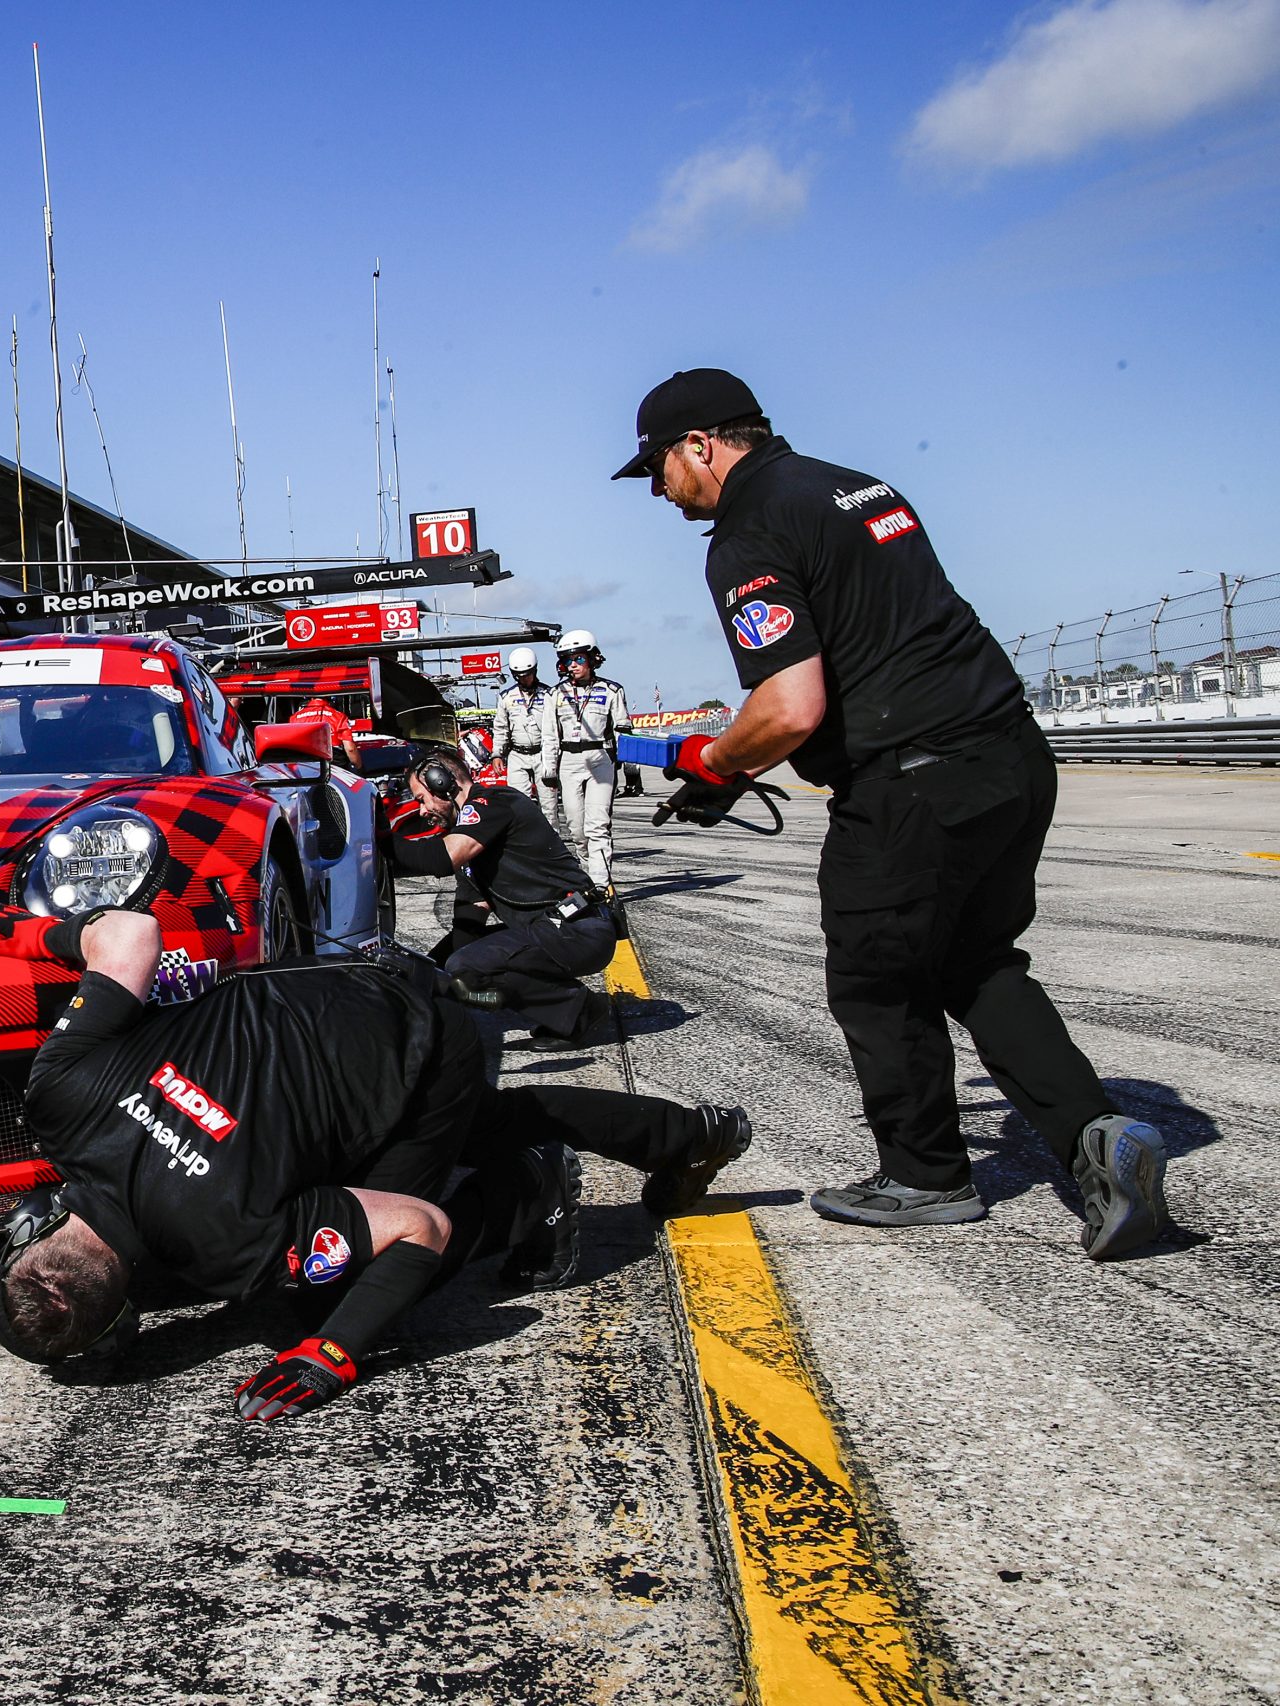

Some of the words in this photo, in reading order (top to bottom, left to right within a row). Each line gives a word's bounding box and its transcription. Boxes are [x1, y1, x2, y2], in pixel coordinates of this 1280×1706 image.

[832, 482, 895, 511] driveway
[422, 521, 465, 555] 10
[869, 510, 915, 541] MOTUL
[368, 567, 429, 583] ACURA
[737, 574, 779, 598] IMSA
[43, 574, 315, 614] ReshapeWork.com
[385, 609, 414, 630] 93
[484, 656, 500, 669] 62
[157, 1066, 232, 1132] MOTUL
[117, 1092, 211, 1177] driveway
